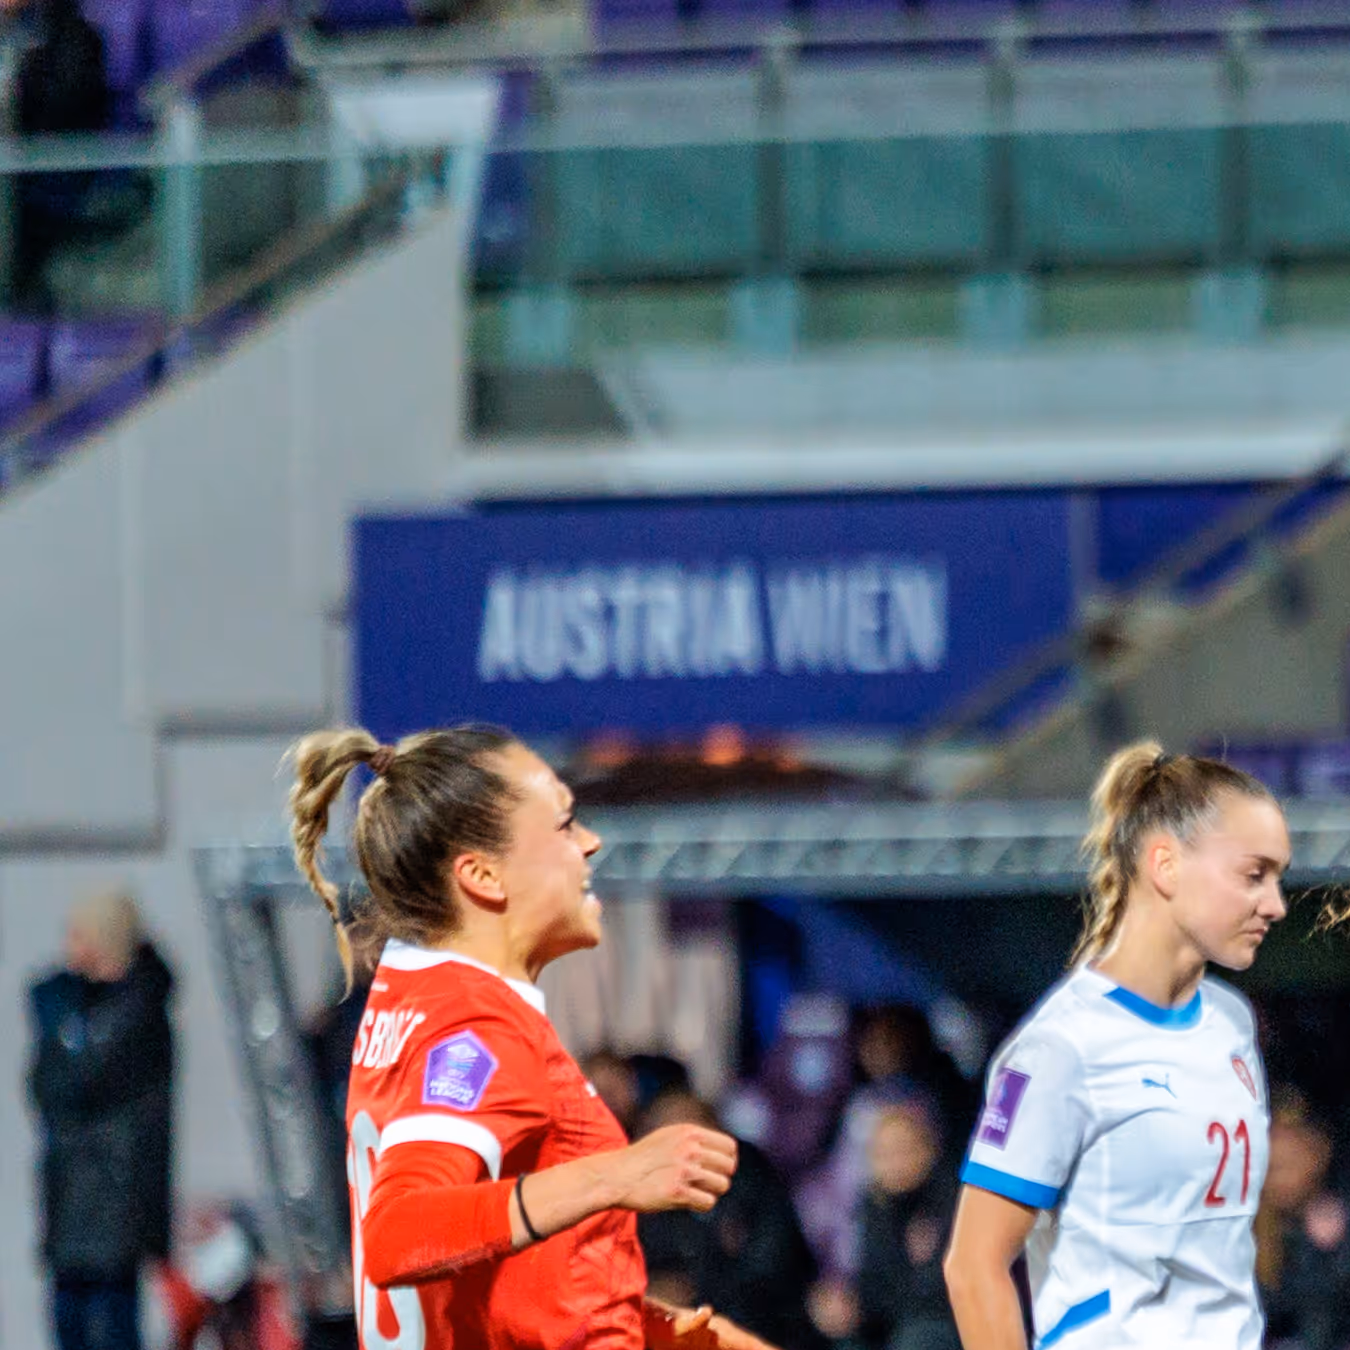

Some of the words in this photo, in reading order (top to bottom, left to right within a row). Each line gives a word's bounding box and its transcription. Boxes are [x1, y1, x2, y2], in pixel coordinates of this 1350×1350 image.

[480, 565, 765, 681] AUSTRIA
[771, 561, 947, 674] WIEN
[1204, 1119, 1250, 1208] 21
